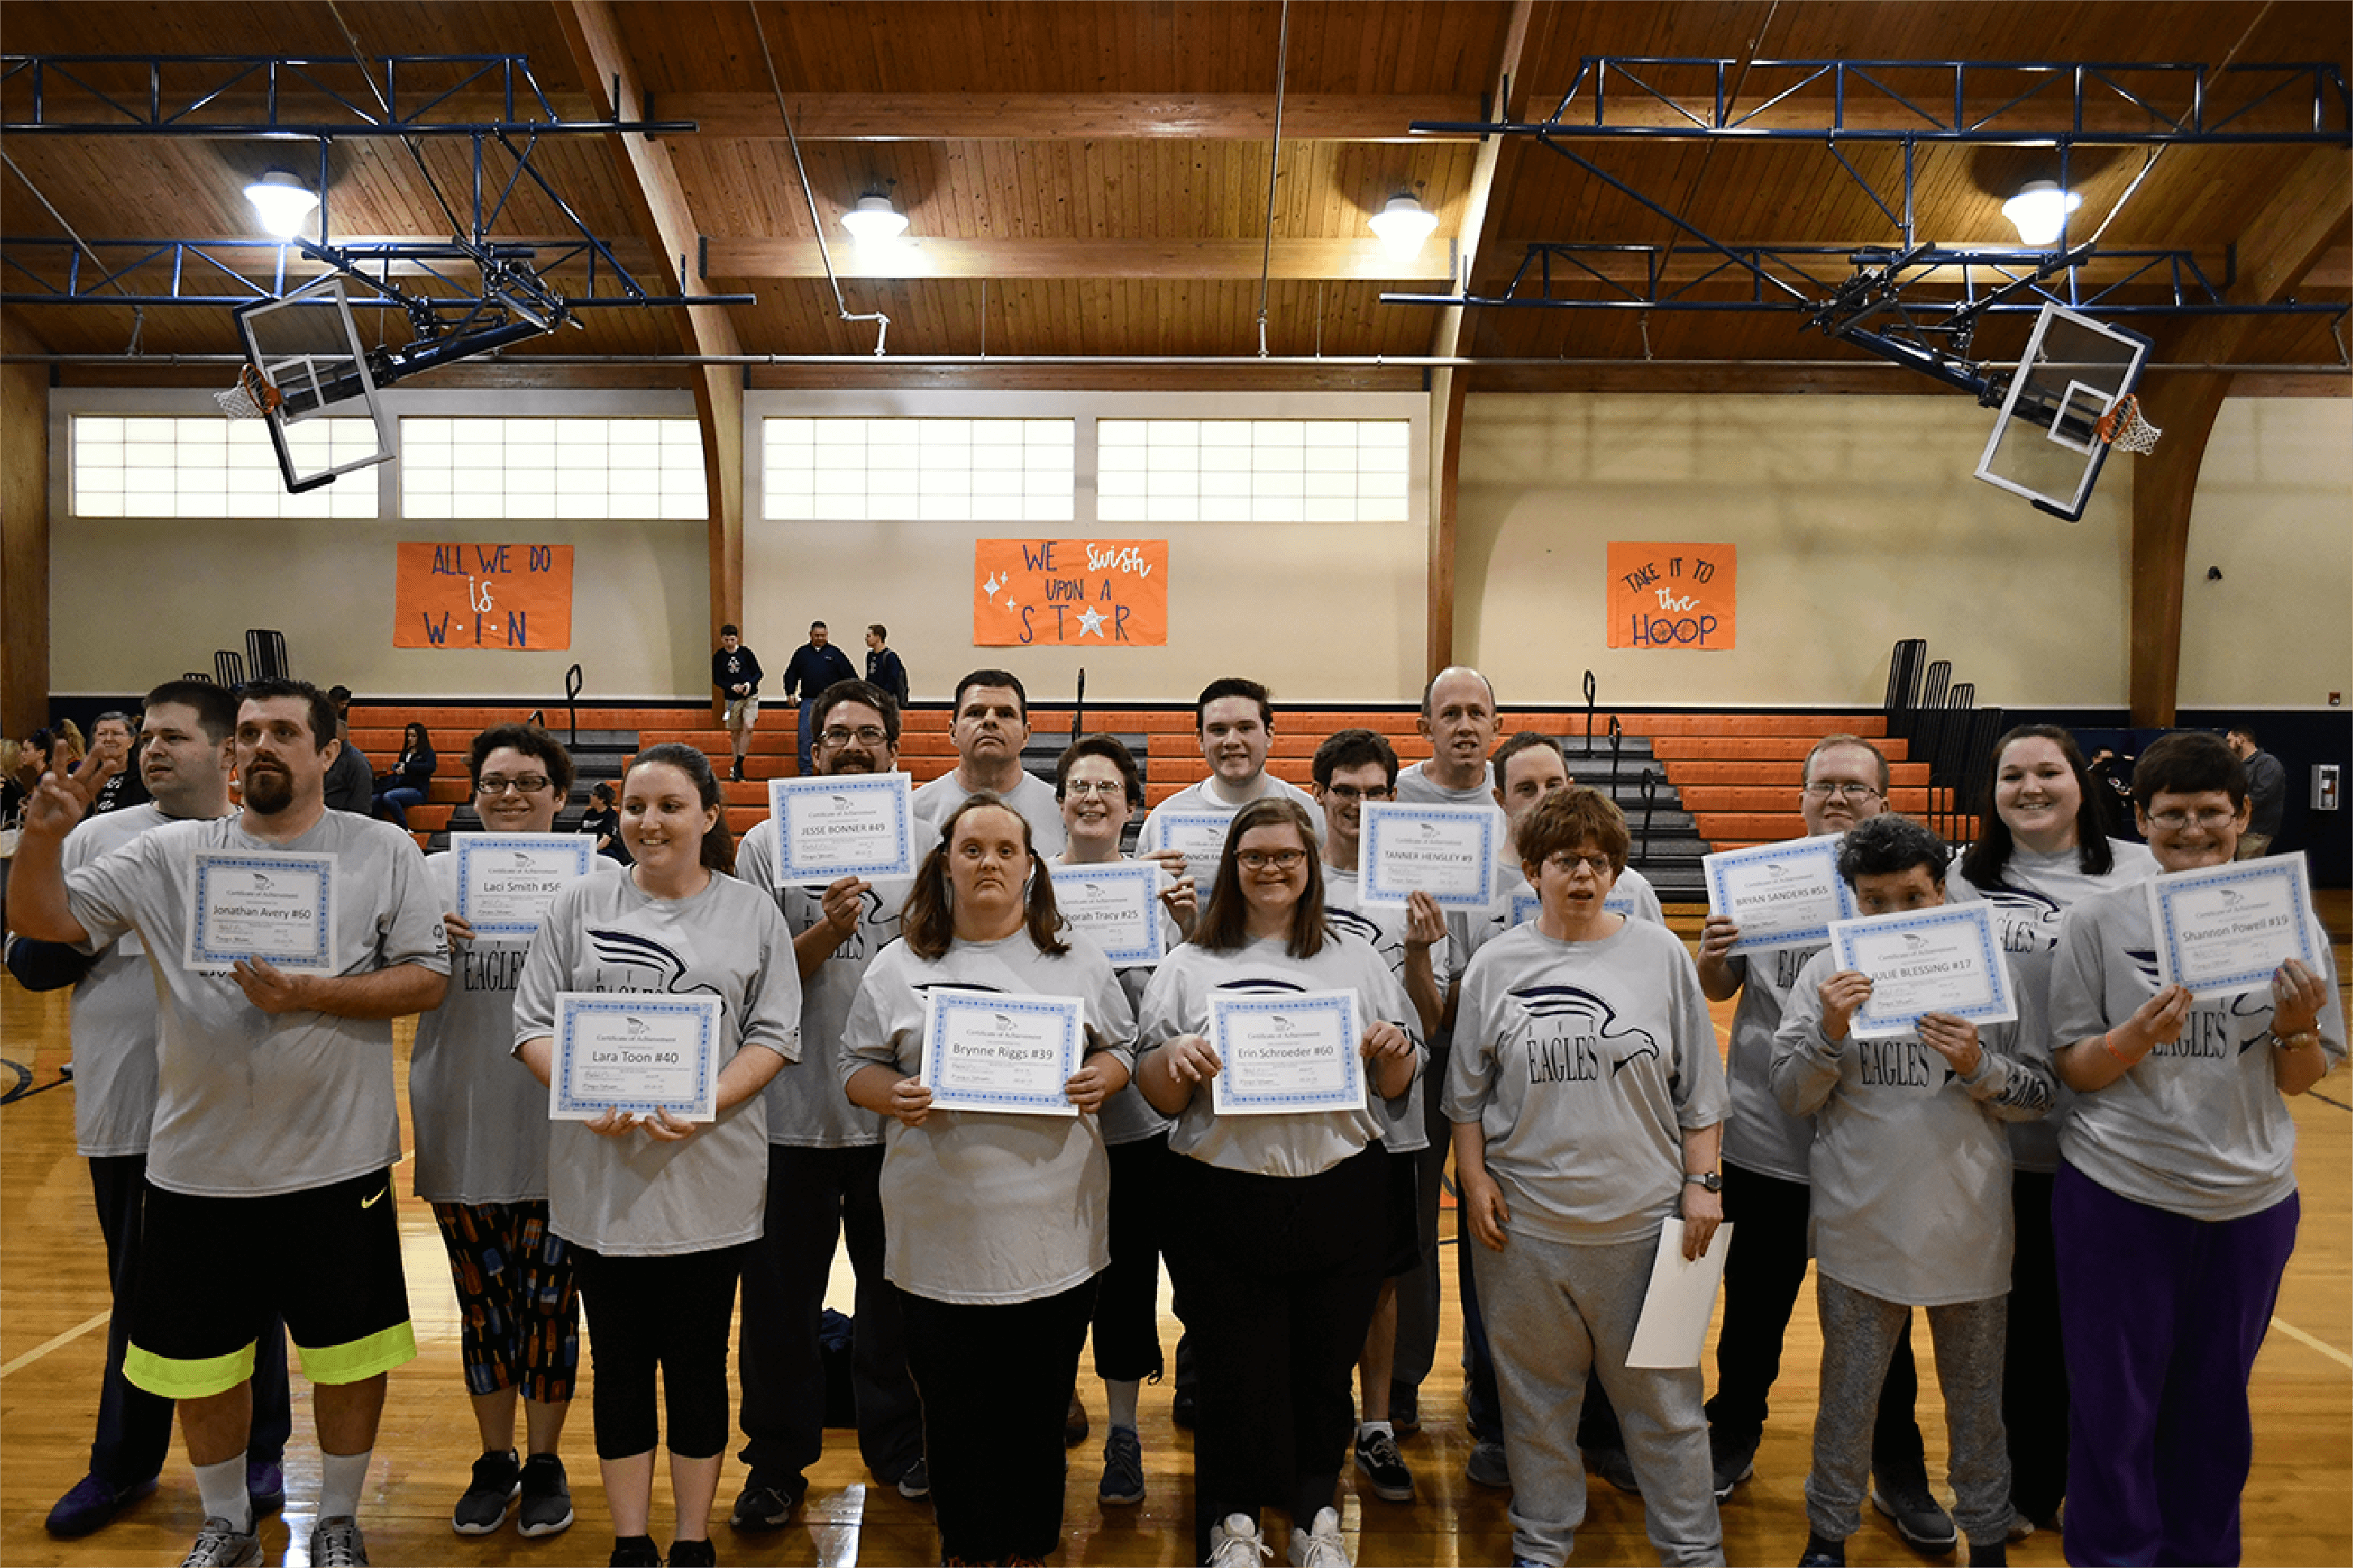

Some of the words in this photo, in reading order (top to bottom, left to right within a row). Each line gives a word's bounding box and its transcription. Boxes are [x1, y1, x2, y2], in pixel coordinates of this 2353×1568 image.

[431, 544, 469, 576] ALL
[474, 544, 512, 574] WE
[529, 545, 552, 573] DO
[1022, 540, 1058, 572] WE
[1622, 562, 1661, 593] TAKE
[1669, 557, 1683, 577] IT
[1692, 558, 1715, 584] TO
[468, 576, 494, 613] is
[1045, 578, 1085, 601] UPON
[1099, 578, 1112, 601] A
[1655, 586, 1700, 613] the
[1632, 613, 1718, 645] HOOP
[483, 882, 504, 893] Laci
[507, 882, 538, 893] Smith
[213, 904, 259, 915] Jonathan
[260, 907, 290, 921] Avery
[2181, 927, 2231, 942] Shannon
[2231, 918, 2266, 933] Powell
[1900, 962, 1949, 978] BLESSING
[592, 1051, 619, 1063] Lara
[621, 1051, 653, 1063] Toon
[654, 1051, 679, 1065] #40
[954, 1042, 994, 1058] Brynne
[998, 1046, 1028, 1061] Riggs
[1031, 1048, 1054, 1061] #39
[1238, 1047, 1258, 1059] Erin
[1259, 1047, 1311, 1059] Schroeder
[1526, 1035, 1598, 1084] EAGLES
[1858, 1041, 1930, 1087] EAGLES
